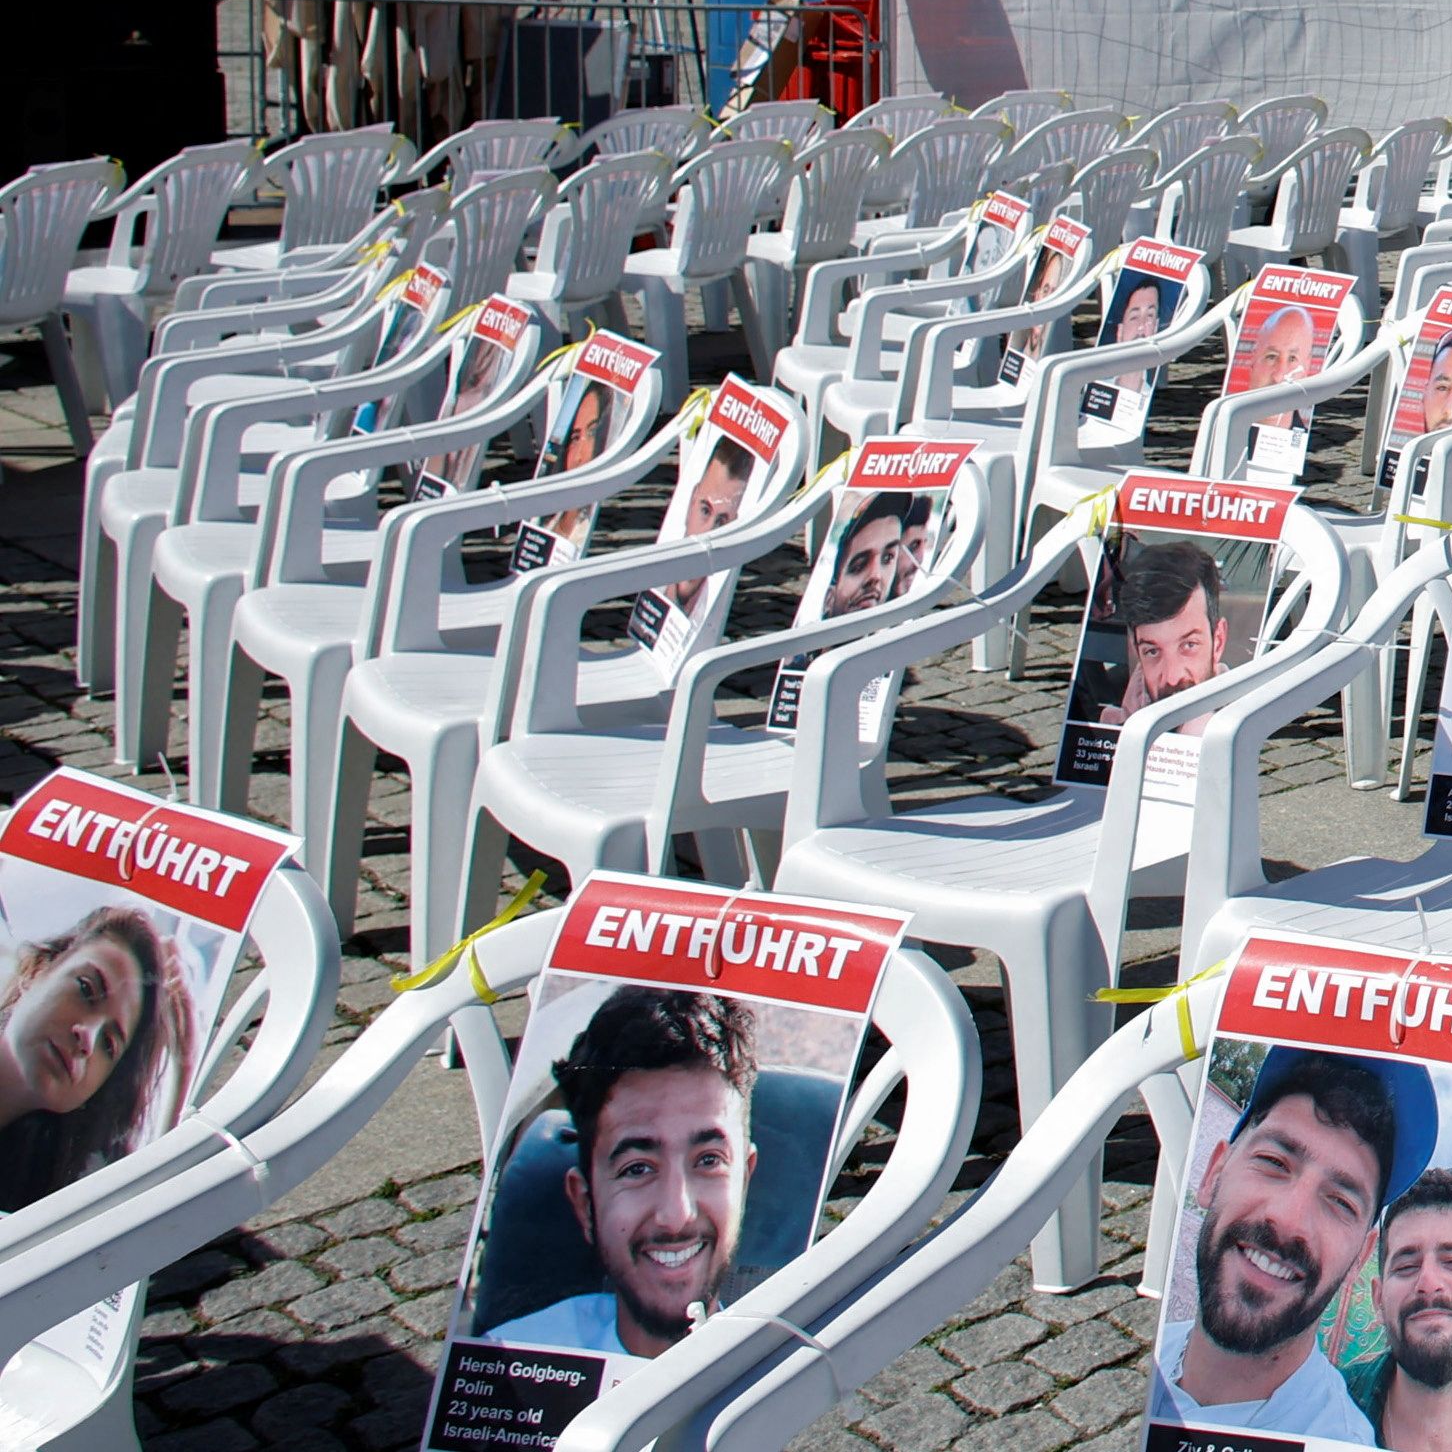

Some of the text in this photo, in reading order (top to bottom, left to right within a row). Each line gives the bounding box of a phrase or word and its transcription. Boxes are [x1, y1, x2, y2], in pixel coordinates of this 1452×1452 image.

[1133, 246, 1190, 272] ENTFÜHRT
[1262, 276, 1343, 299] ENTFÜHRT
[585, 341, 642, 380] ENTFÜHRT
[720, 395, 780, 447] ENTFÜHRT
[862, 451, 957, 480] ENTFÜHRT
[1128, 488, 1276, 525] ENTFÜHRT
[1078, 737, 1102, 749] David
[1073, 761, 1099, 771] Israeli
[1076, 750, 1111, 763] 33 years
[28, 799, 250, 897] ENTFÜHRT
[585, 906, 861, 980] ENTFÜHRT
[458, 1356, 587, 1387] Hersh Golgberg-
[454, 1378, 494, 1396] Polin
[448, 1400, 544, 1424] 23 years old
[443, 1422, 557, 1448] Israeli-America
